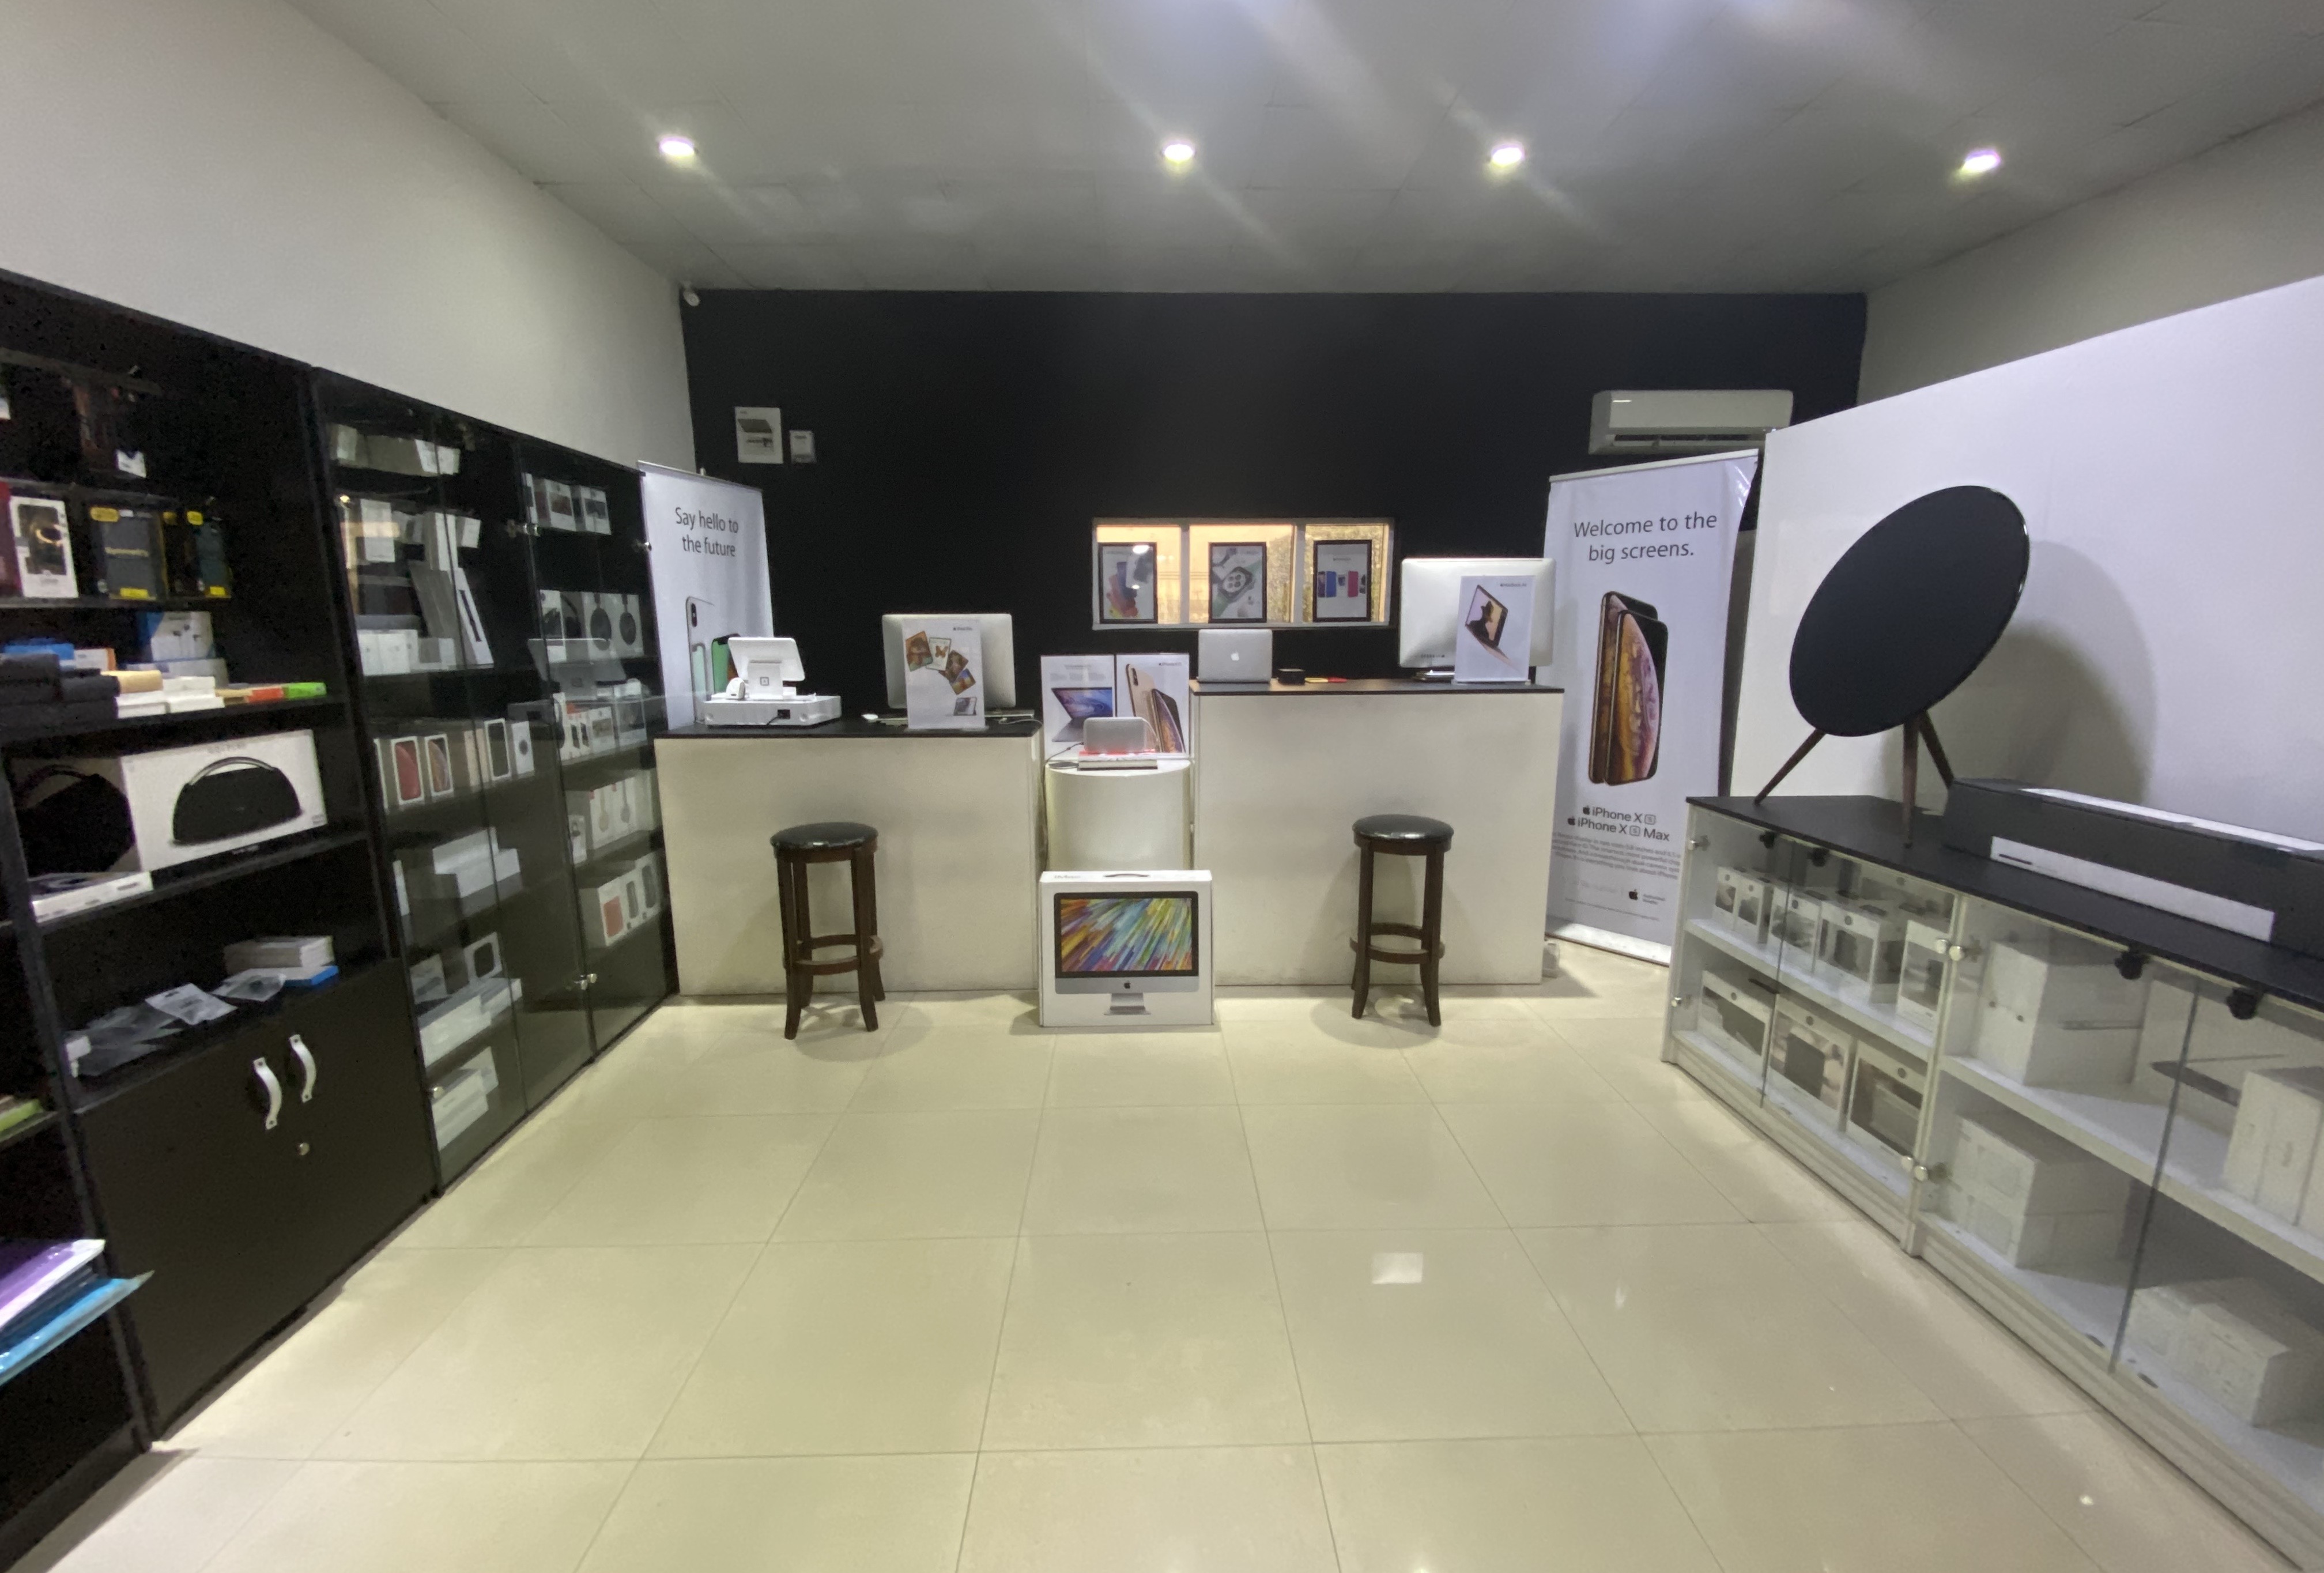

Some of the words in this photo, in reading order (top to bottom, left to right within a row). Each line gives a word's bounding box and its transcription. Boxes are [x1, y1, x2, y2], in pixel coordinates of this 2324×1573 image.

[675, 507, 696, 530] Say
[699, 510, 726, 531] hello
[728, 518, 739, 533] to
[1574, 519, 1653, 537] Welcome
[1659, 516, 1678, 531] to
[1684, 511, 1717, 530] the
[682, 534, 701, 553] the
[703, 537, 735, 557] future
[1589, 545, 1615, 564] big
[1621, 543, 1694, 559] screens.
[1592, 806, 1632, 821] iPhone
[1578, 817, 1617, 833] iPhone
[1643, 827, 1670, 842] Max
